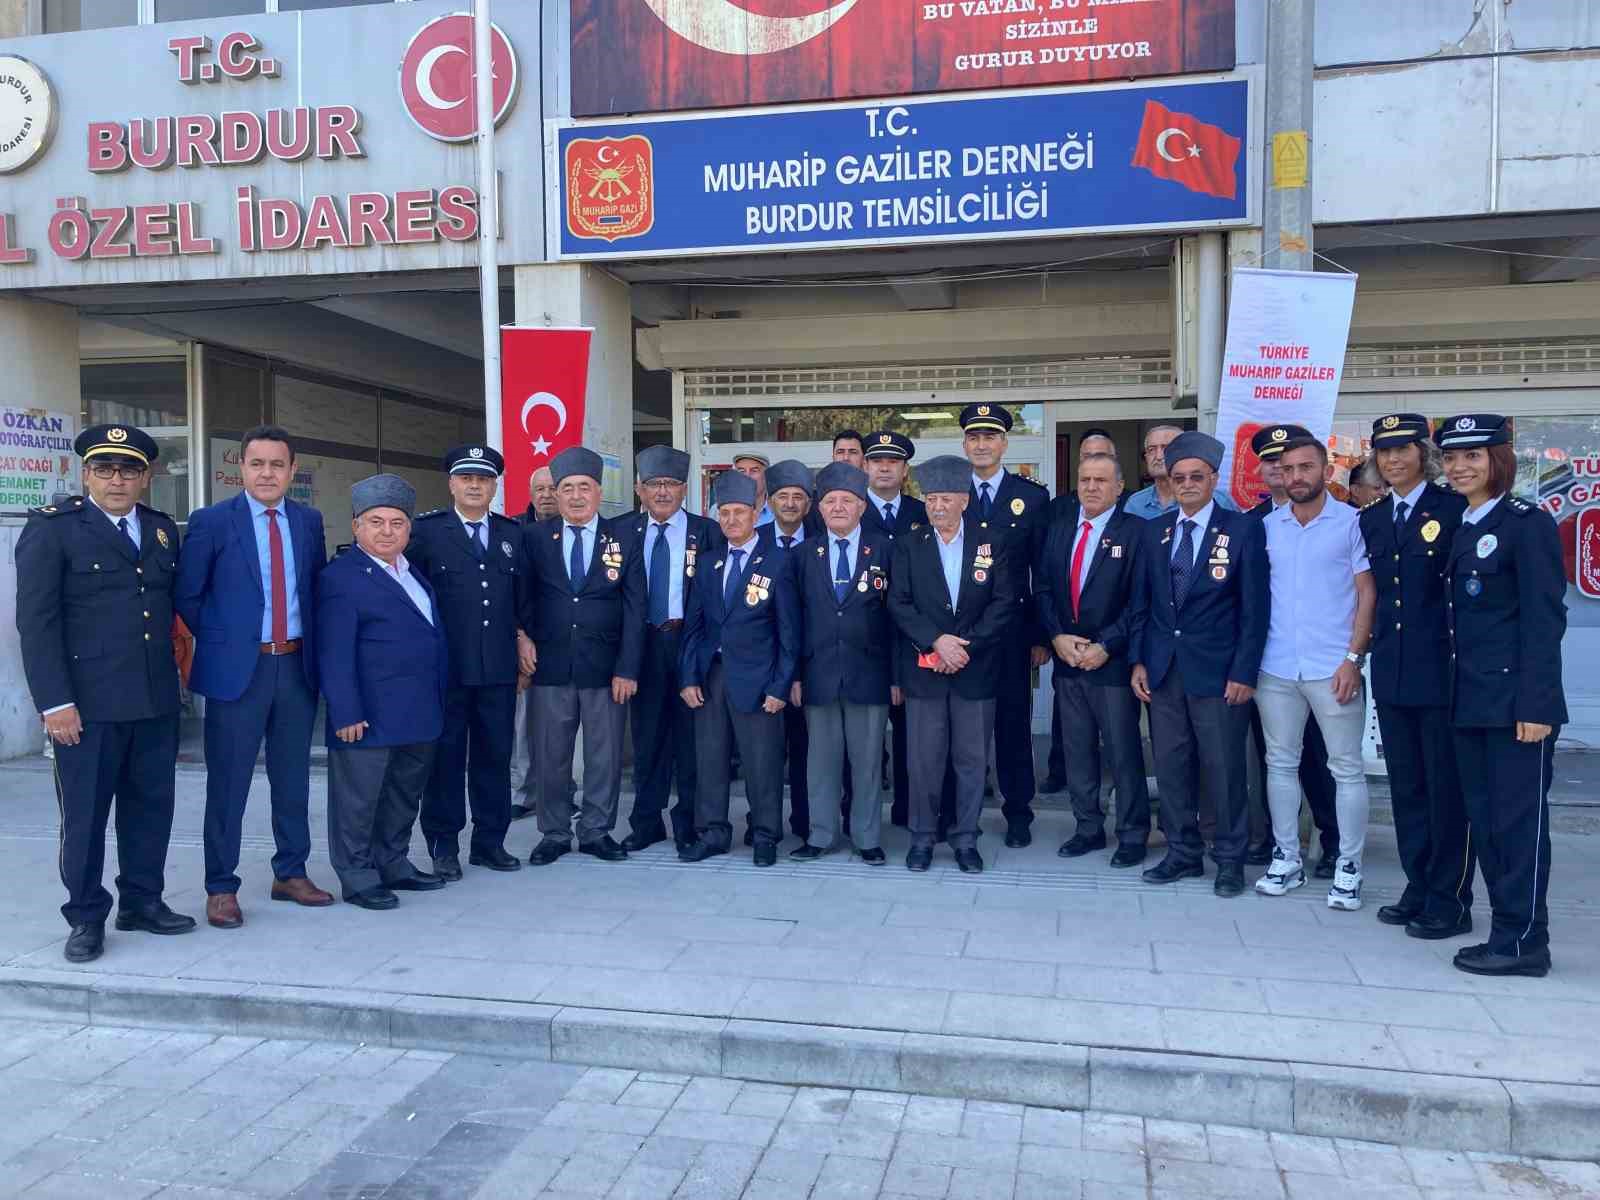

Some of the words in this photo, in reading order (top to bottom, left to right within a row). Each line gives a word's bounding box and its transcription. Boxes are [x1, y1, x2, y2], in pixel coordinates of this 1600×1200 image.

[923, 4, 953, 20] BU
[1005, 17, 1098, 40] SİZİNLE
[168, 31, 278, 82] T.C.
[955, 50, 1035, 71] GURUR
[1039, 41, 1152, 65] DUYUYOR
[865, 107, 918, 137] T.C.
[88, 105, 364, 172] BURDUR
[704, 151, 826, 193] MUHARİP
[836, 145, 952, 185] GAZİLER
[962, 132, 1094, 176] DERNEĞİ
[47, 197, 215, 261] ÖZEL
[237, 184, 498, 252] İDARES
[746, 200, 853, 234] BURDUR
[863, 181, 1048, 228] TEMSİLCİLİĞİ
[1260, 342, 1310, 360] TÜRKİYE
[1229, 362, 1282, 379] MUHARİP
[1285, 363, 1336, 381] GAZİLER
[1254, 383, 1304, 400] DERNEĞİ
[3, 407, 63, 433] ÖZKAN
